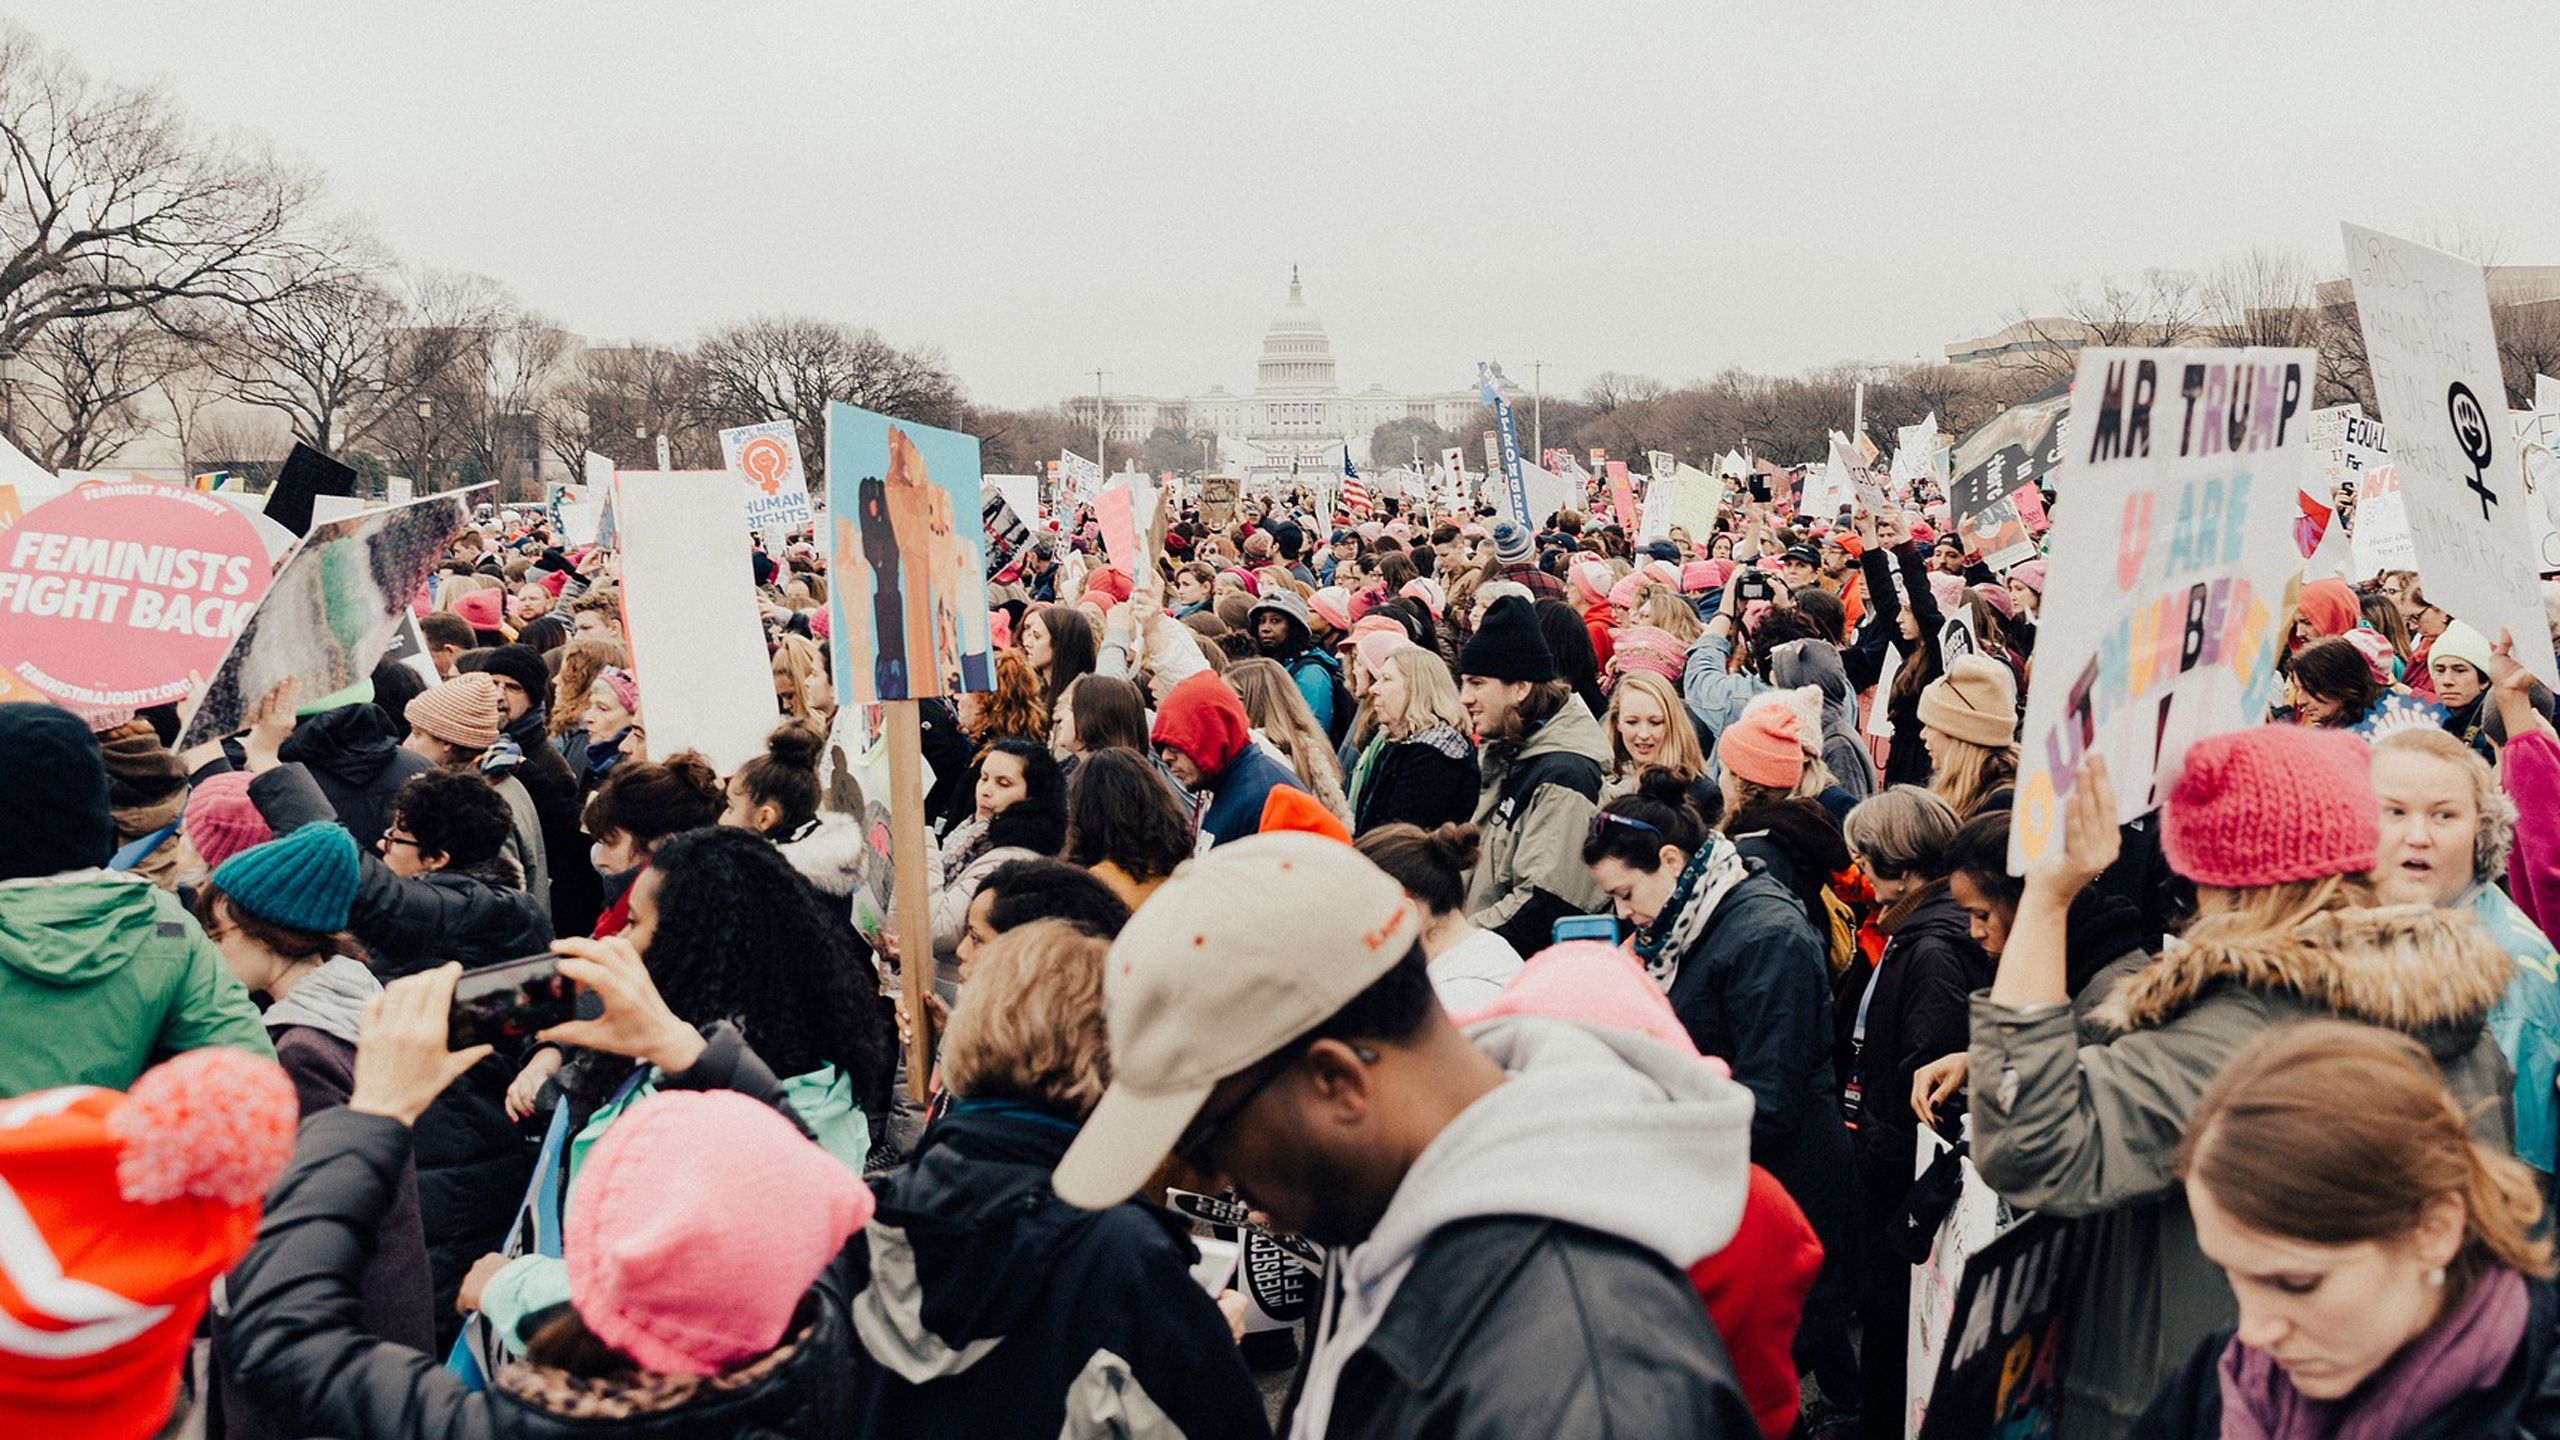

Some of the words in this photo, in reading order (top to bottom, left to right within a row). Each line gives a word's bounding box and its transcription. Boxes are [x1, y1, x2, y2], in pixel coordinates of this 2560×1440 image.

[2089, 358, 2158, 464] MR
[2179, 362, 2302, 457] TRUMP
[2346, 416, 2388, 454] EQUAL
[1499, 402, 1526, 524] STRONGER
[82, 484, 155, 501] FEMINIST
[154, 485, 230, 517] MAJORITY
[745, 491, 806, 514] HUMAN
[747, 507, 810, 530] RIGHTS
[2115, 491, 2156, 592] U
[2165, 473, 2255, 578] ARE
[9, 530, 252, 597] FEMINISTS
[0, 571, 129, 624] FIGHT
[128, 588, 257, 639] BACK
